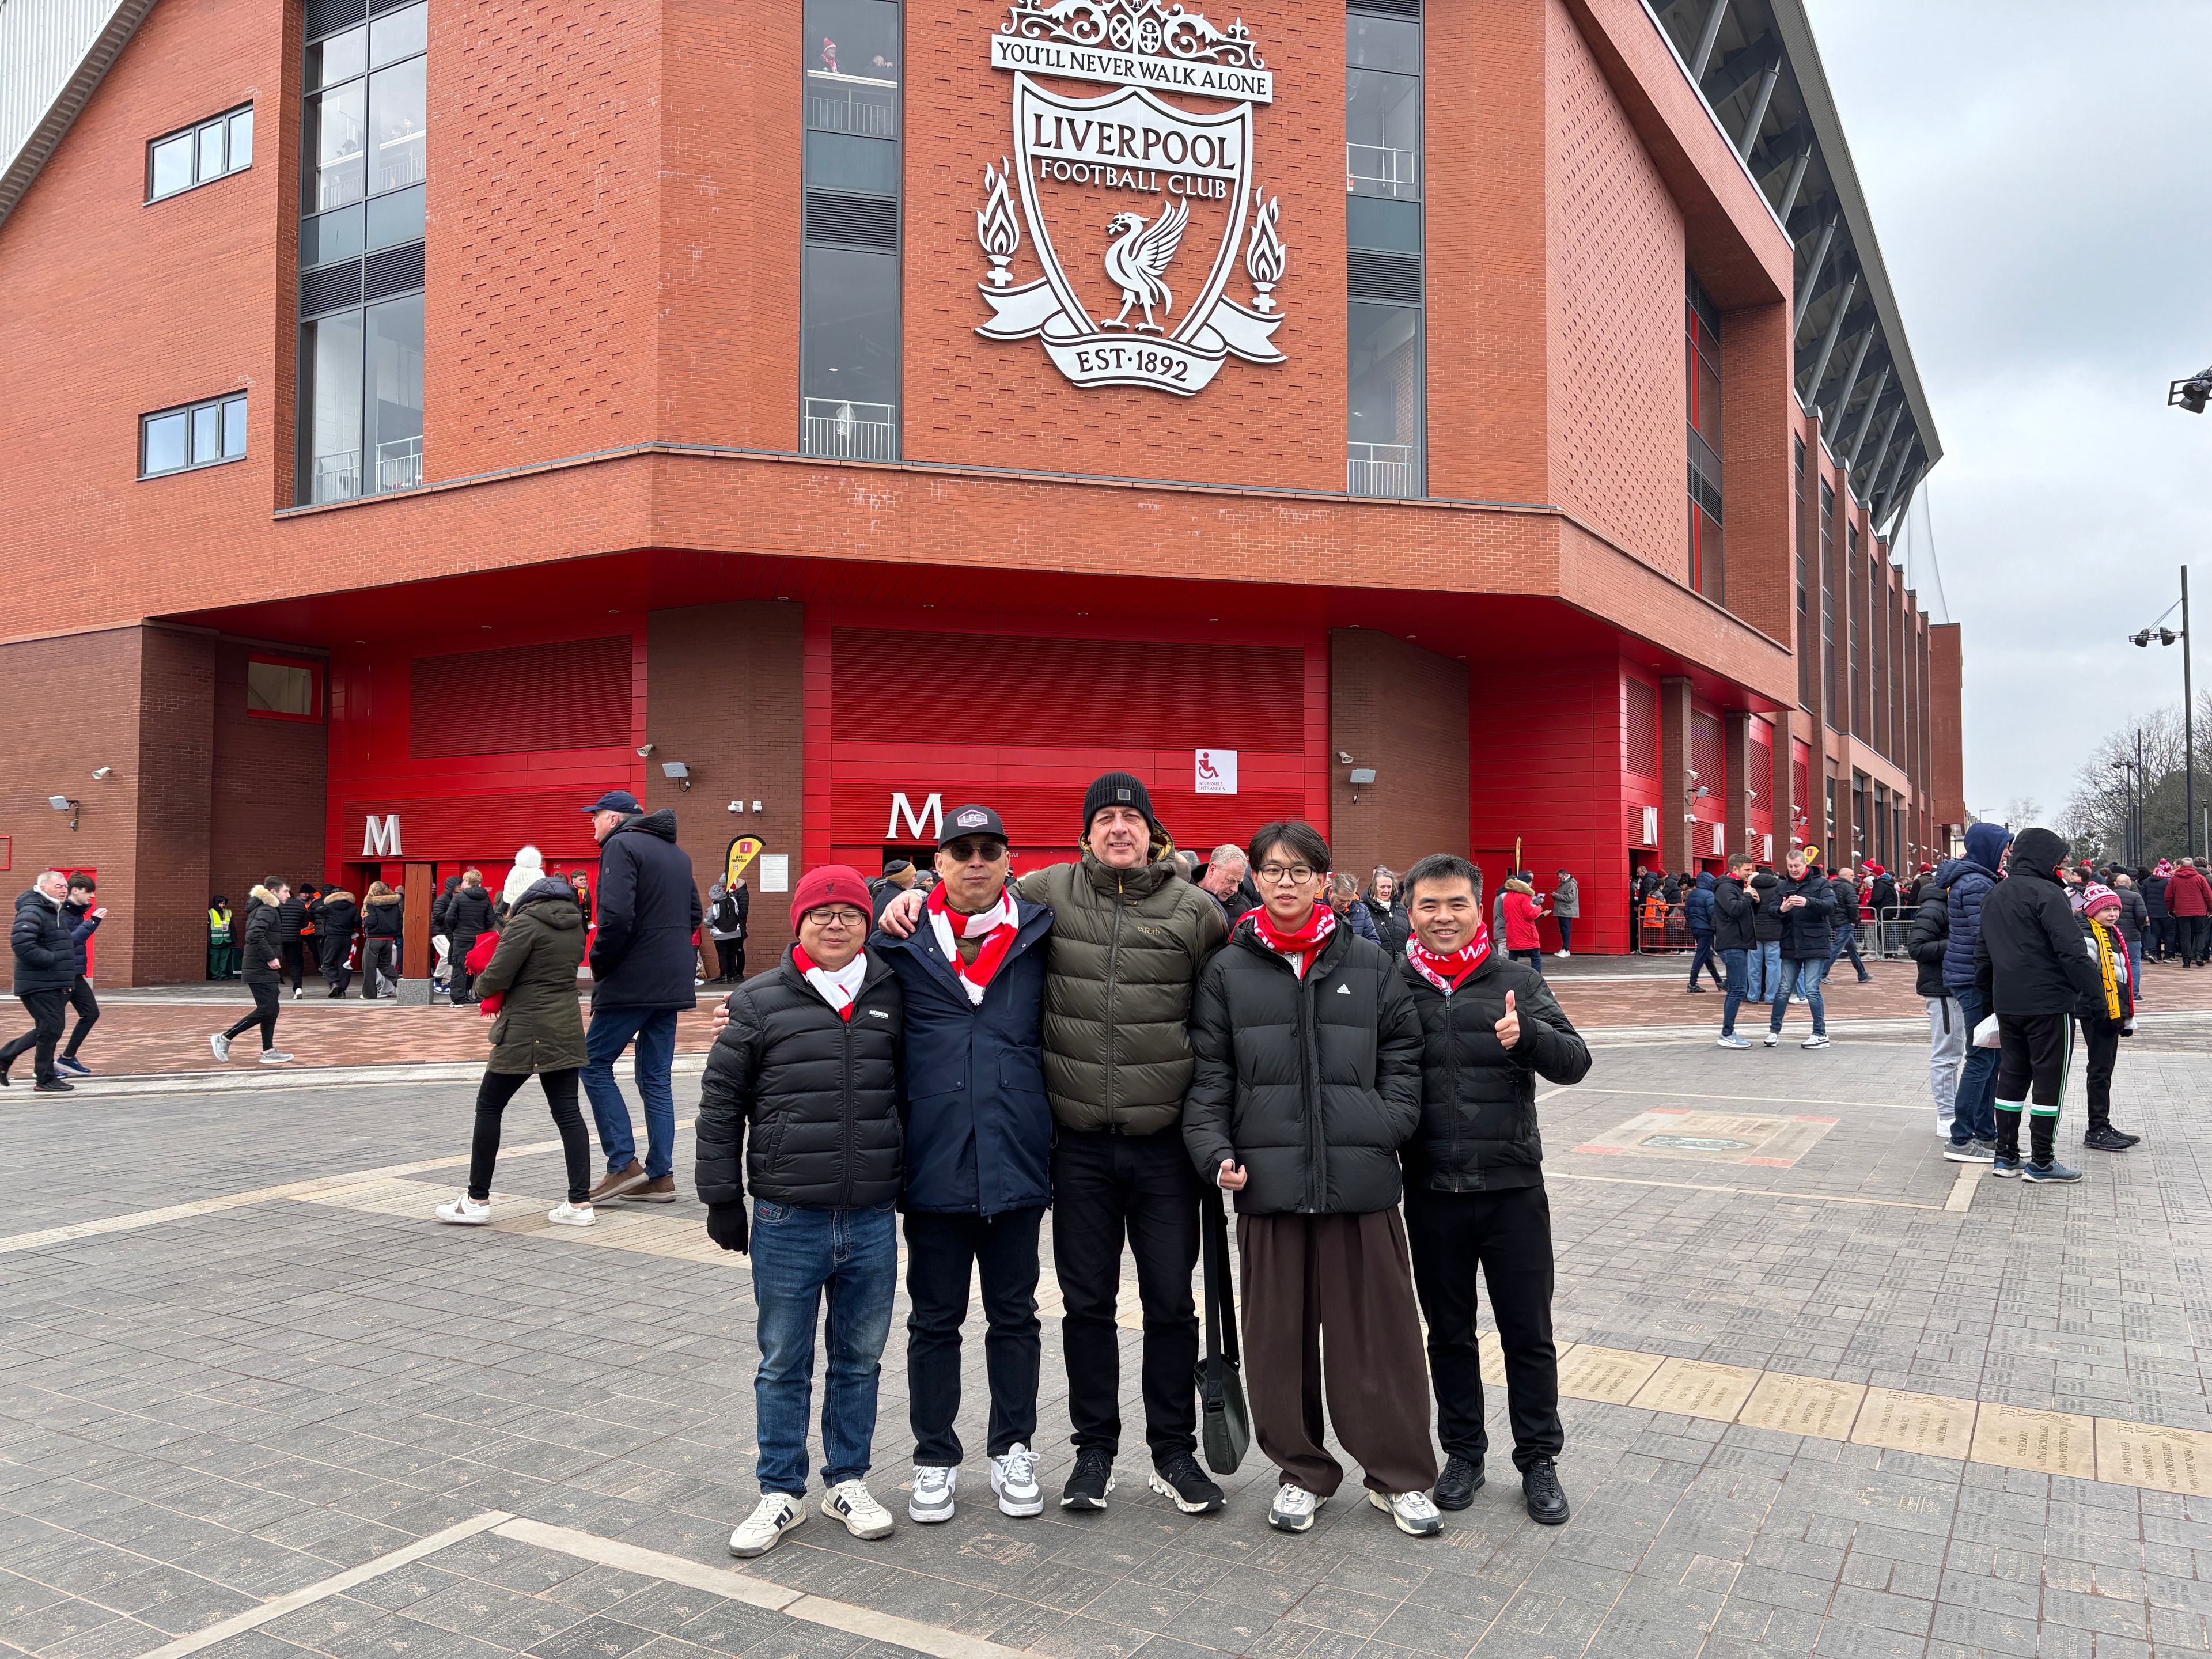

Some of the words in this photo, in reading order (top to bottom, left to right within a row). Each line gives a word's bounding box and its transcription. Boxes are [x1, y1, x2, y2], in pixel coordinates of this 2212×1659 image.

[997, 41, 1066, 69] YOU'LL
[1070, 52, 1137, 77] NEVER
[1138, 61, 1197, 86] WALK
[1196, 71, 1266, 95] ALONE
[1032, 113, 1236, 171] LIVERPOOL
[1040, 159, 1161, 191] FOOTBALL
[1168, 175, 1227, 199] CLUB
[885, 793, 943, 840] M
[963, 813, 983, 824] LFC
[362, 815, 403, 857] M
[1145, 927, 1160, 935] Rab
[869, 1010, 889, 1018] MORROW
[555, 1627, 597, 1648] KETTERING
[577, 1624, 616, 1643] WILDMAN
[551, 1643, 581, 1657] FAMILY
